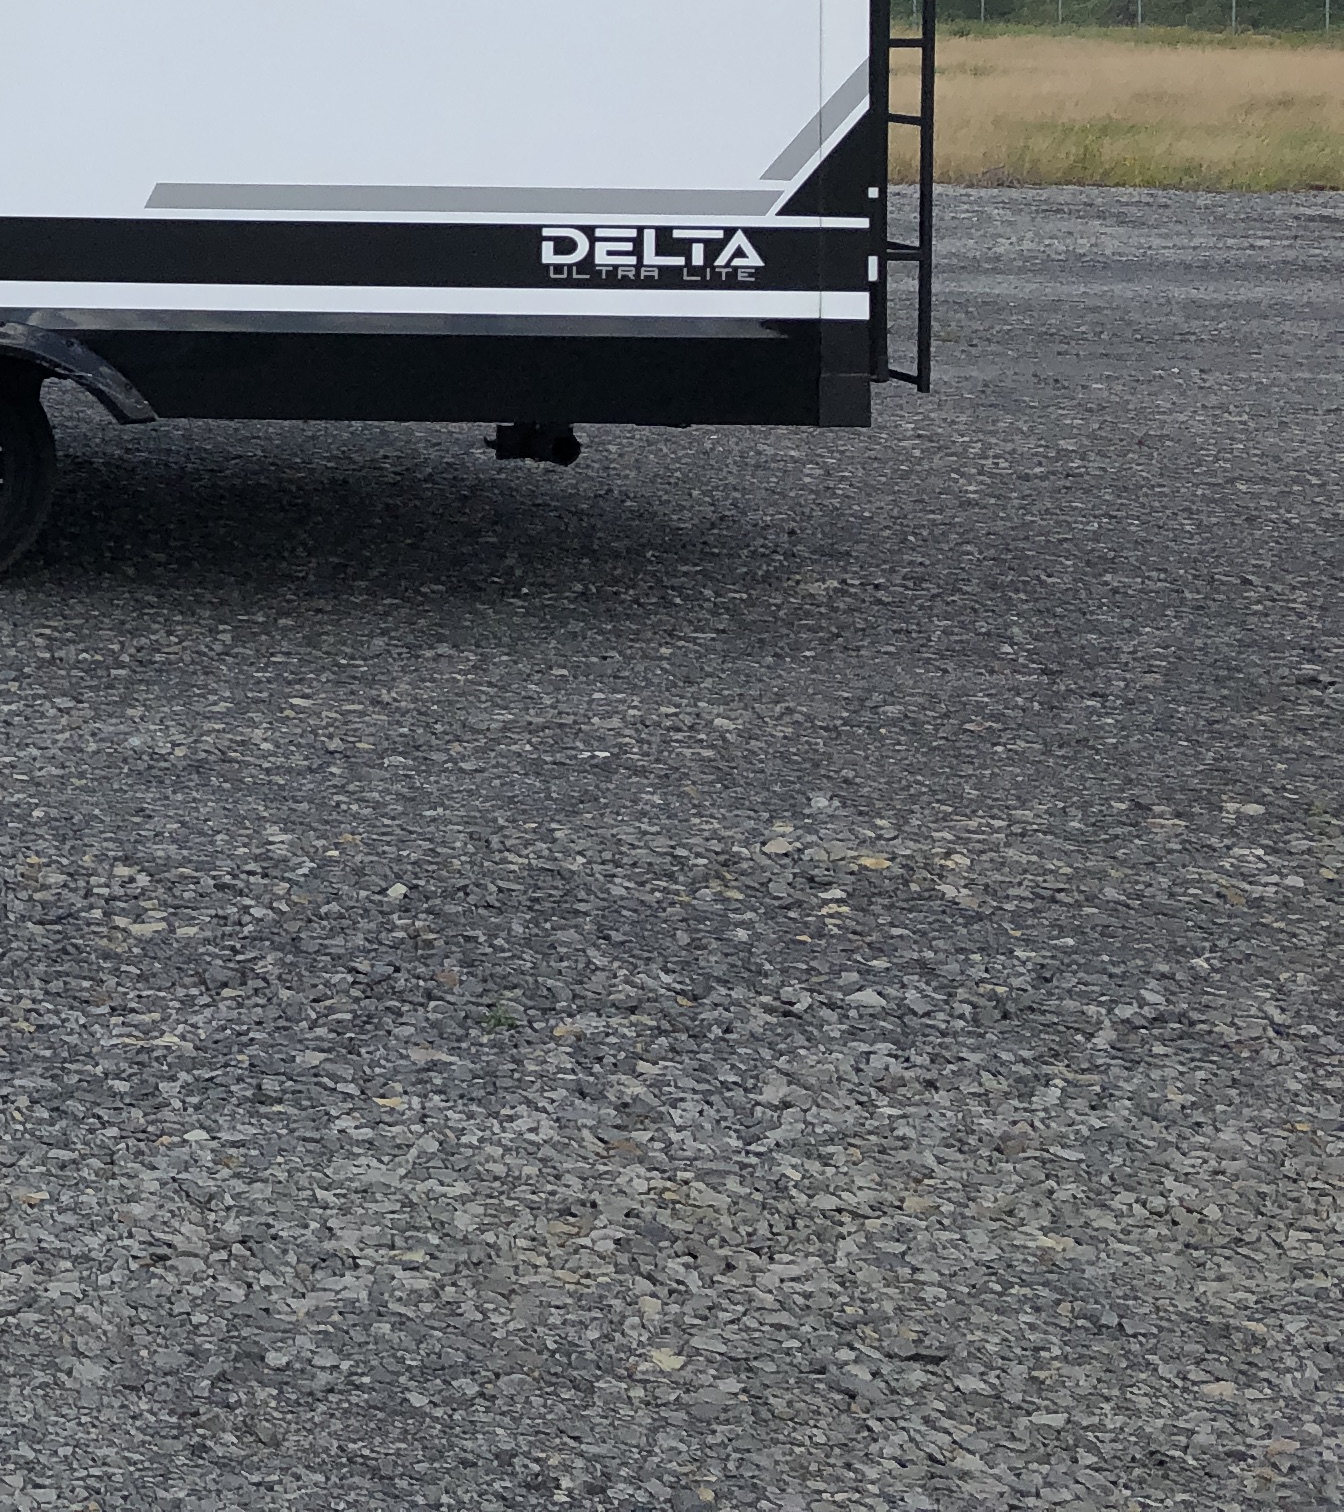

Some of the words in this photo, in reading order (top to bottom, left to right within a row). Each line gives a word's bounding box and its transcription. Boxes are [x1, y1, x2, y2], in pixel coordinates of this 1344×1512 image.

[541, 227, 766, 267] DELTA
[549, 265, 659, 280] ULTRA
[682, 267, 756, 281] LITE
